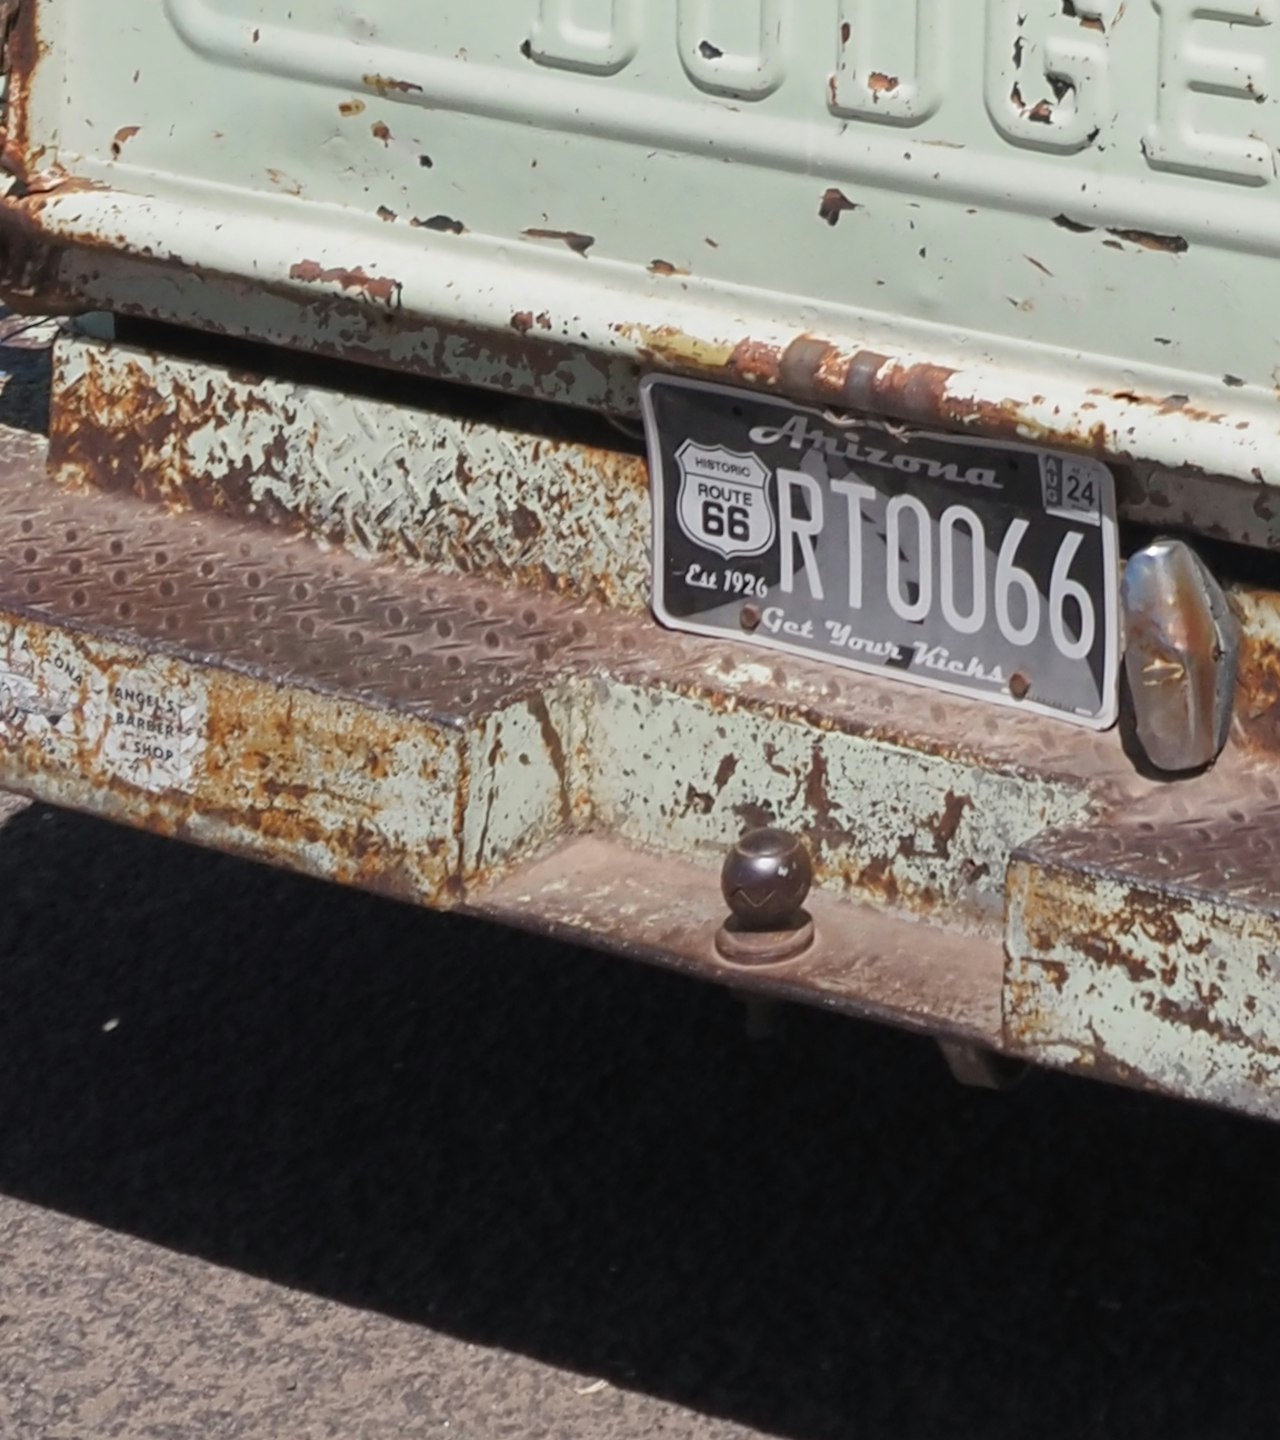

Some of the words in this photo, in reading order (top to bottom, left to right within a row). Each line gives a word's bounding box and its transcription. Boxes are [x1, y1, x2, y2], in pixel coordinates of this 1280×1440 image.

[695, 456, 751, 478] HISTORIC
[749, 415, 1004, 489] Arizona
[698, 483, 753, 507] ROUTE
[1067, 475, 1095, 507] 24
[702, 499, 751, 543] 66
[776, 468, 1096, 660] RT0066
[685, 563, 718, 590] Est
[723, 569, 769, 599] 1926
[762, 606, 814, 639] Get
[825, 619, 903, 661] Your
[913, 641, 1005, 683] Kicks
[114, 687, 174, 713] ANGEL'S
[115, 711, 175, 737] BARBER
[134, 741, 174, 762] SHOP
